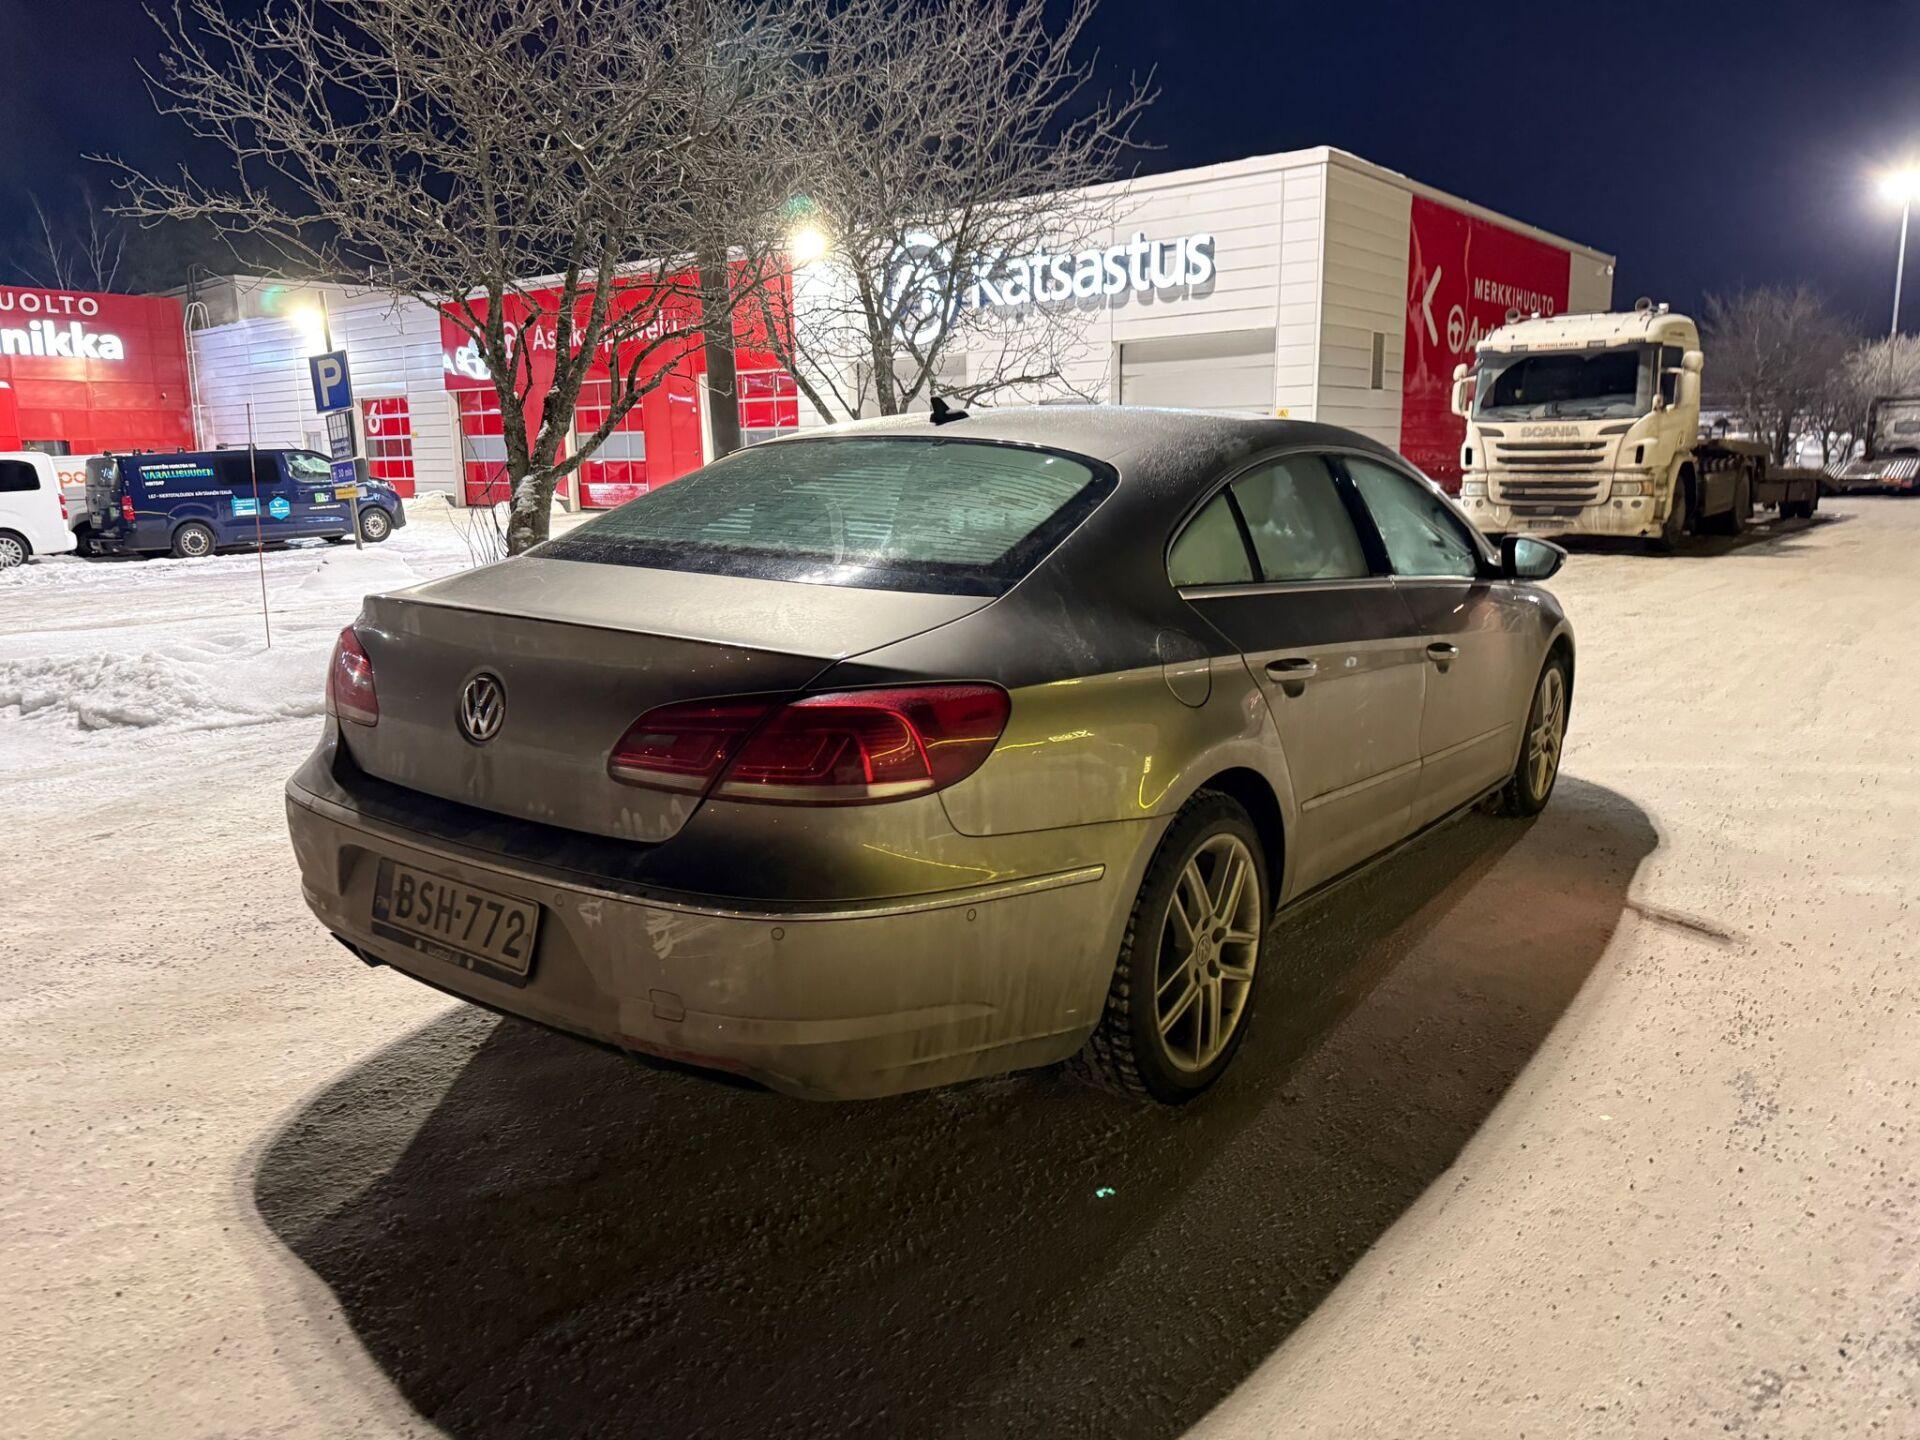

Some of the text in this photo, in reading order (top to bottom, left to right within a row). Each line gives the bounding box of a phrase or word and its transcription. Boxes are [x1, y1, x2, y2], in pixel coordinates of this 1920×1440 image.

[970, 231, 1213, 308] Katsastus
[1474, 277, 1554, 316] MERKKIHUOLTO
[0, 320, 124, 360] nikka
[317, 358, 342, 407] P
[368, 402, 380, 434] 6
[1520, 426, 1580, 437] SCANIA
[143, 468, 214, 480] VARALLISUUDEN
[395, 873, 526, 959] BSH-772
